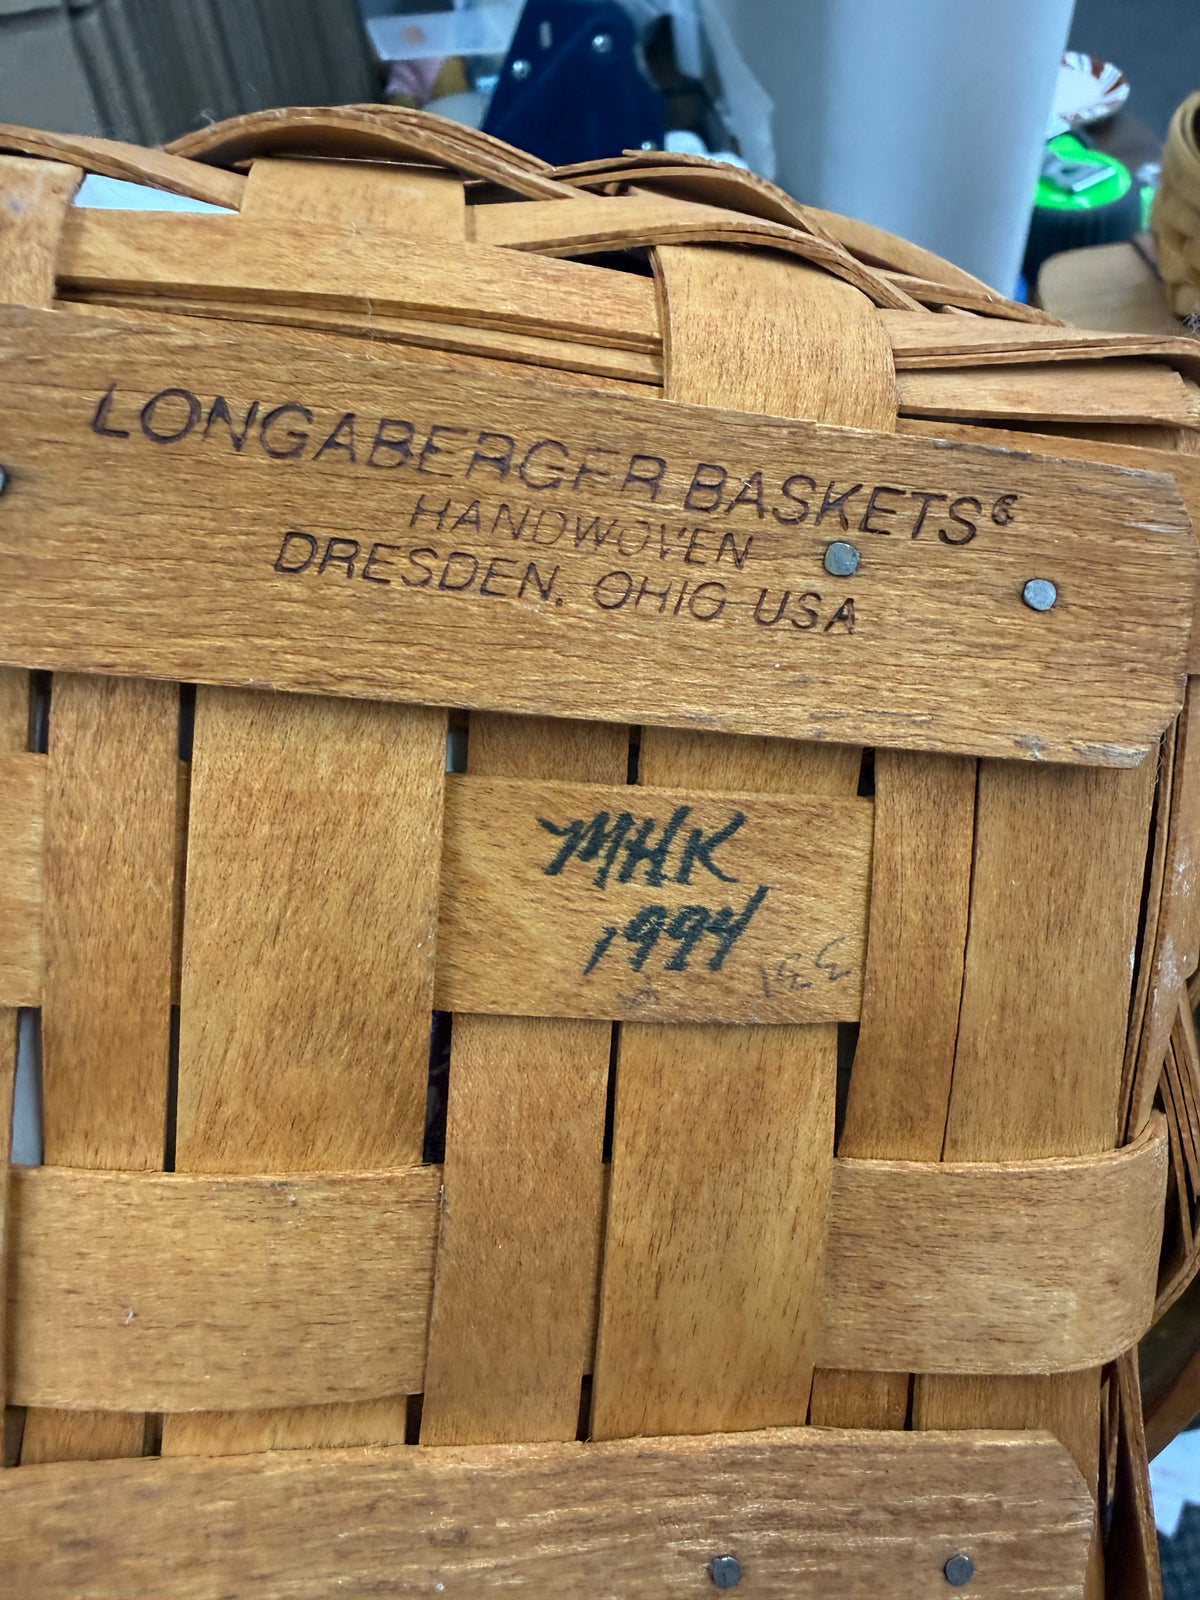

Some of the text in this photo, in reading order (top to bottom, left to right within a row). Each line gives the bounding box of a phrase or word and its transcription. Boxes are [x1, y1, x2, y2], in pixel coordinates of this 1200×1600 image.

[93, 382, 667, 500] LONGABERGER
[409, 494, 754, 570] HANDWOVEN
[593, 570, 727, 621] OHIO
[754, 588, 856, 634] USA
[537, 805, 748, 890] MHK
[583, 885, 771, 976] 1994
